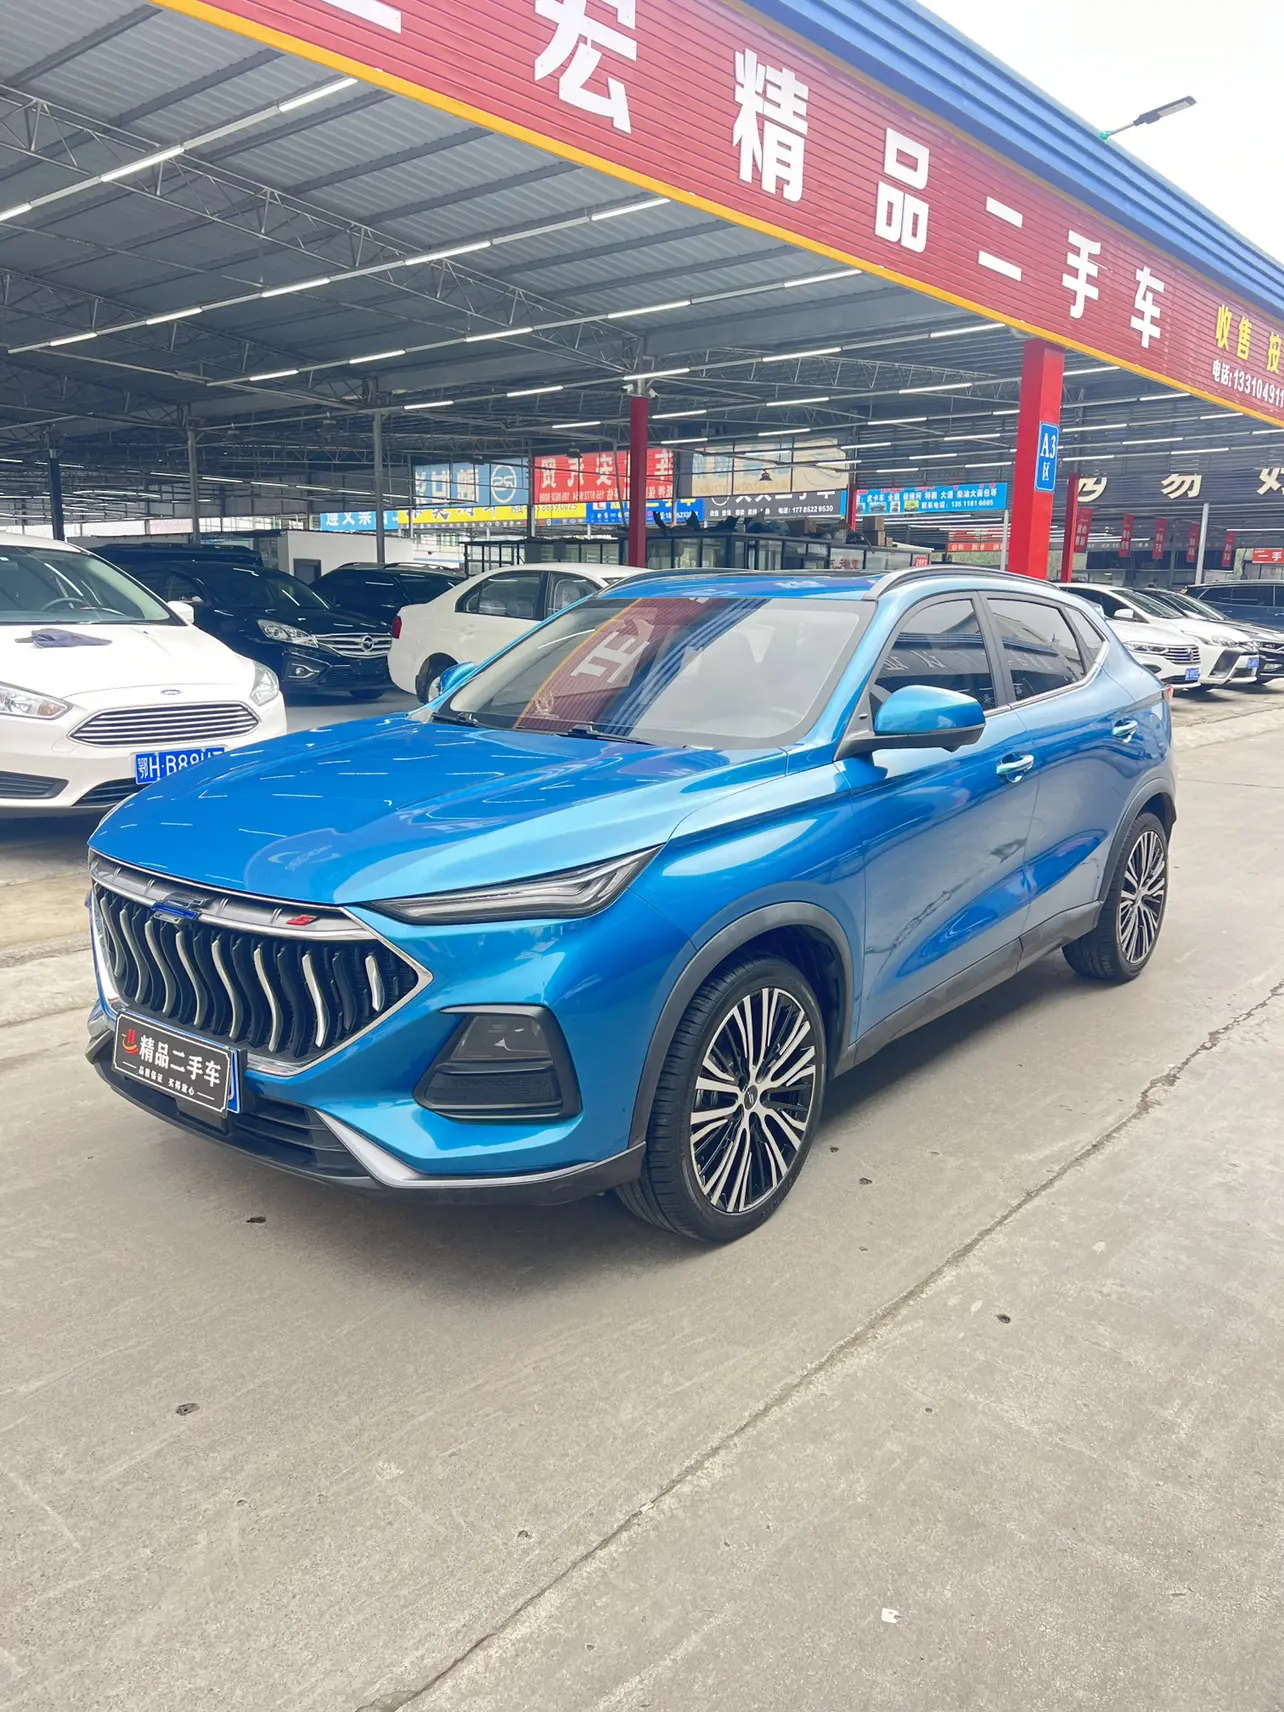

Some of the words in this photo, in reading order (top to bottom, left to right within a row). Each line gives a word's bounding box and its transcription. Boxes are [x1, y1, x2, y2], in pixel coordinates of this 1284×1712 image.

[1215, 304, 1253, 361] 收售
[1040, 432, 1057, 459] A3
[1042, 461, 1051, 481] 区
[138, 1034, 221, 1087] 精品二手车
[138, 1065, 164, 1083] 品质保证
[167, 1078, 195, 1096] 买得放心
